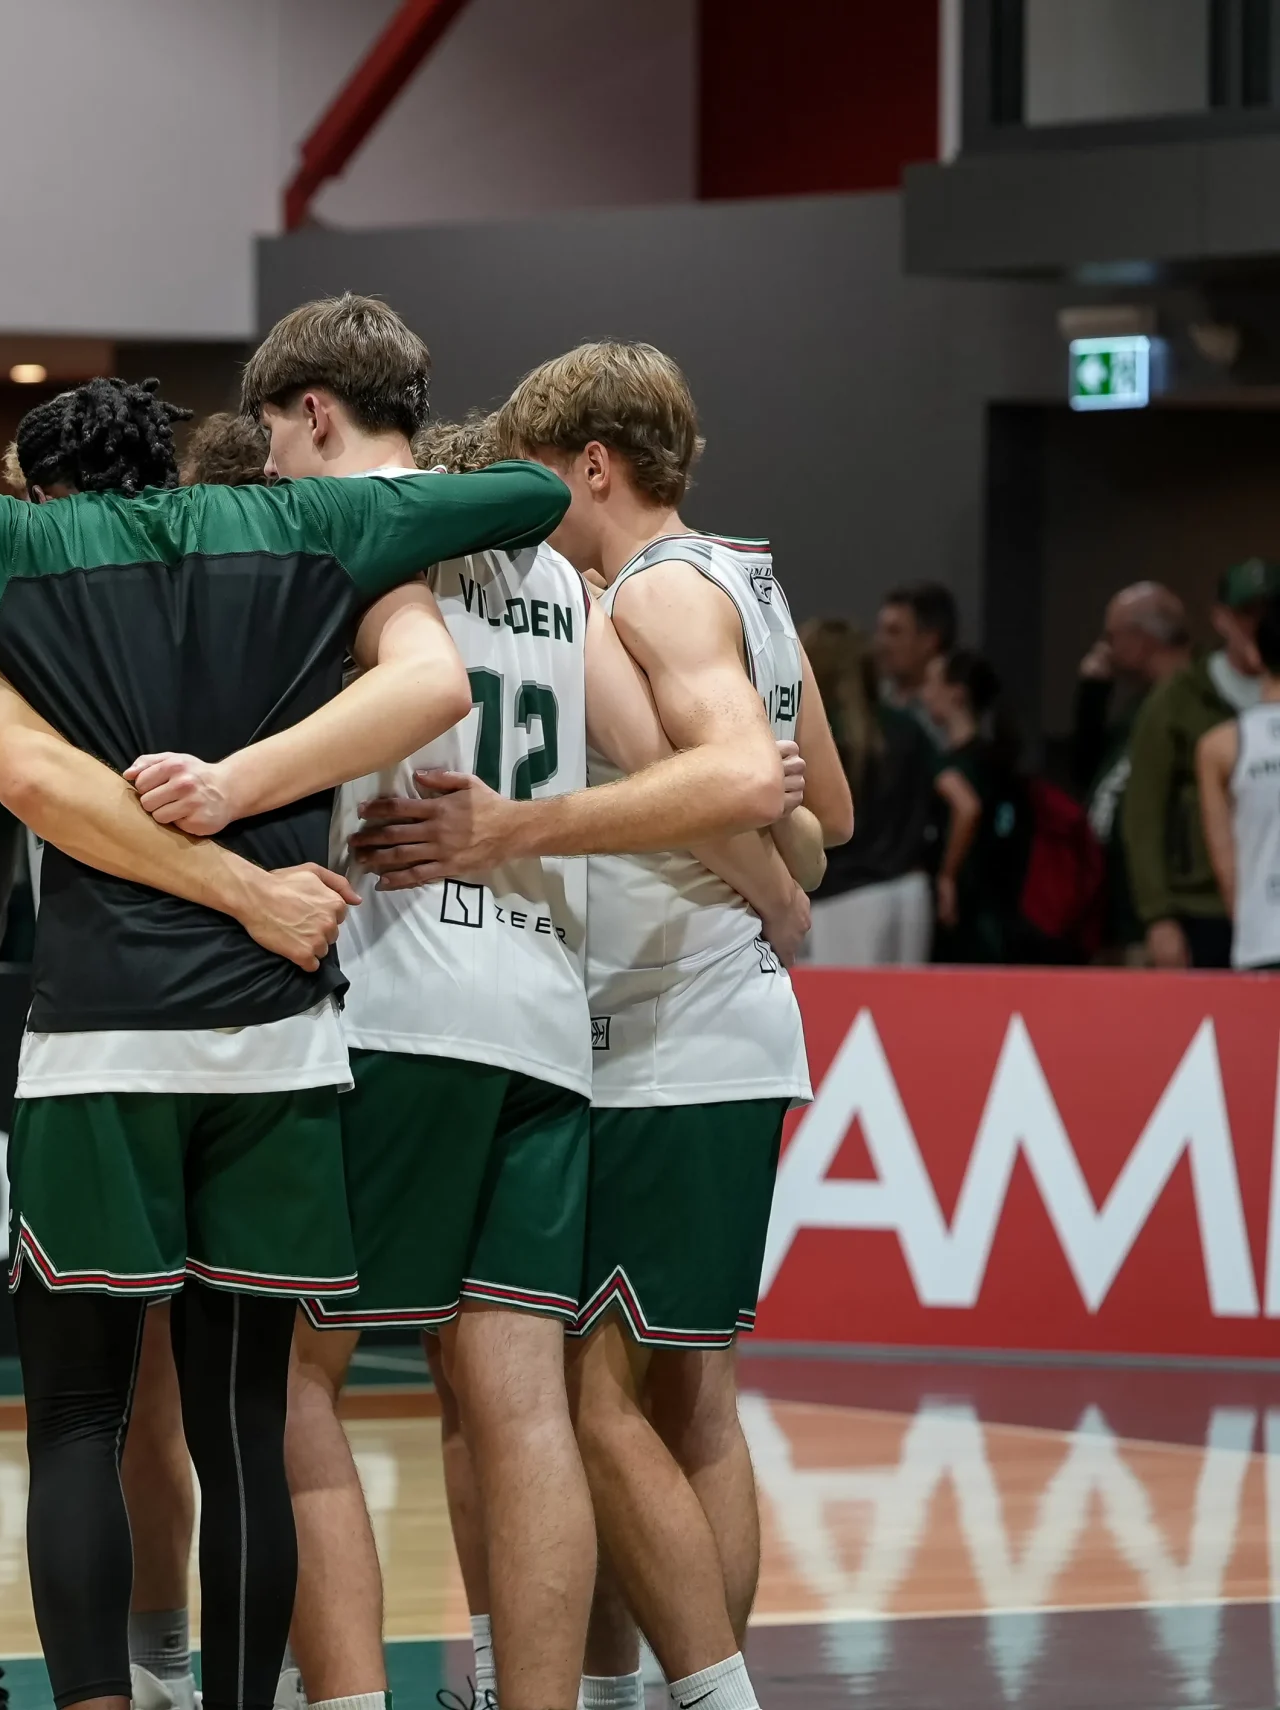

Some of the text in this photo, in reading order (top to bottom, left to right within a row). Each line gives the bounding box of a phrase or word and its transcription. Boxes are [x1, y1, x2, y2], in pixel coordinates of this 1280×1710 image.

[465, 666, 559, 801] 12
[494, 904, 567, 945] ZEER
[757, 1005, 1280, 1319] AM
